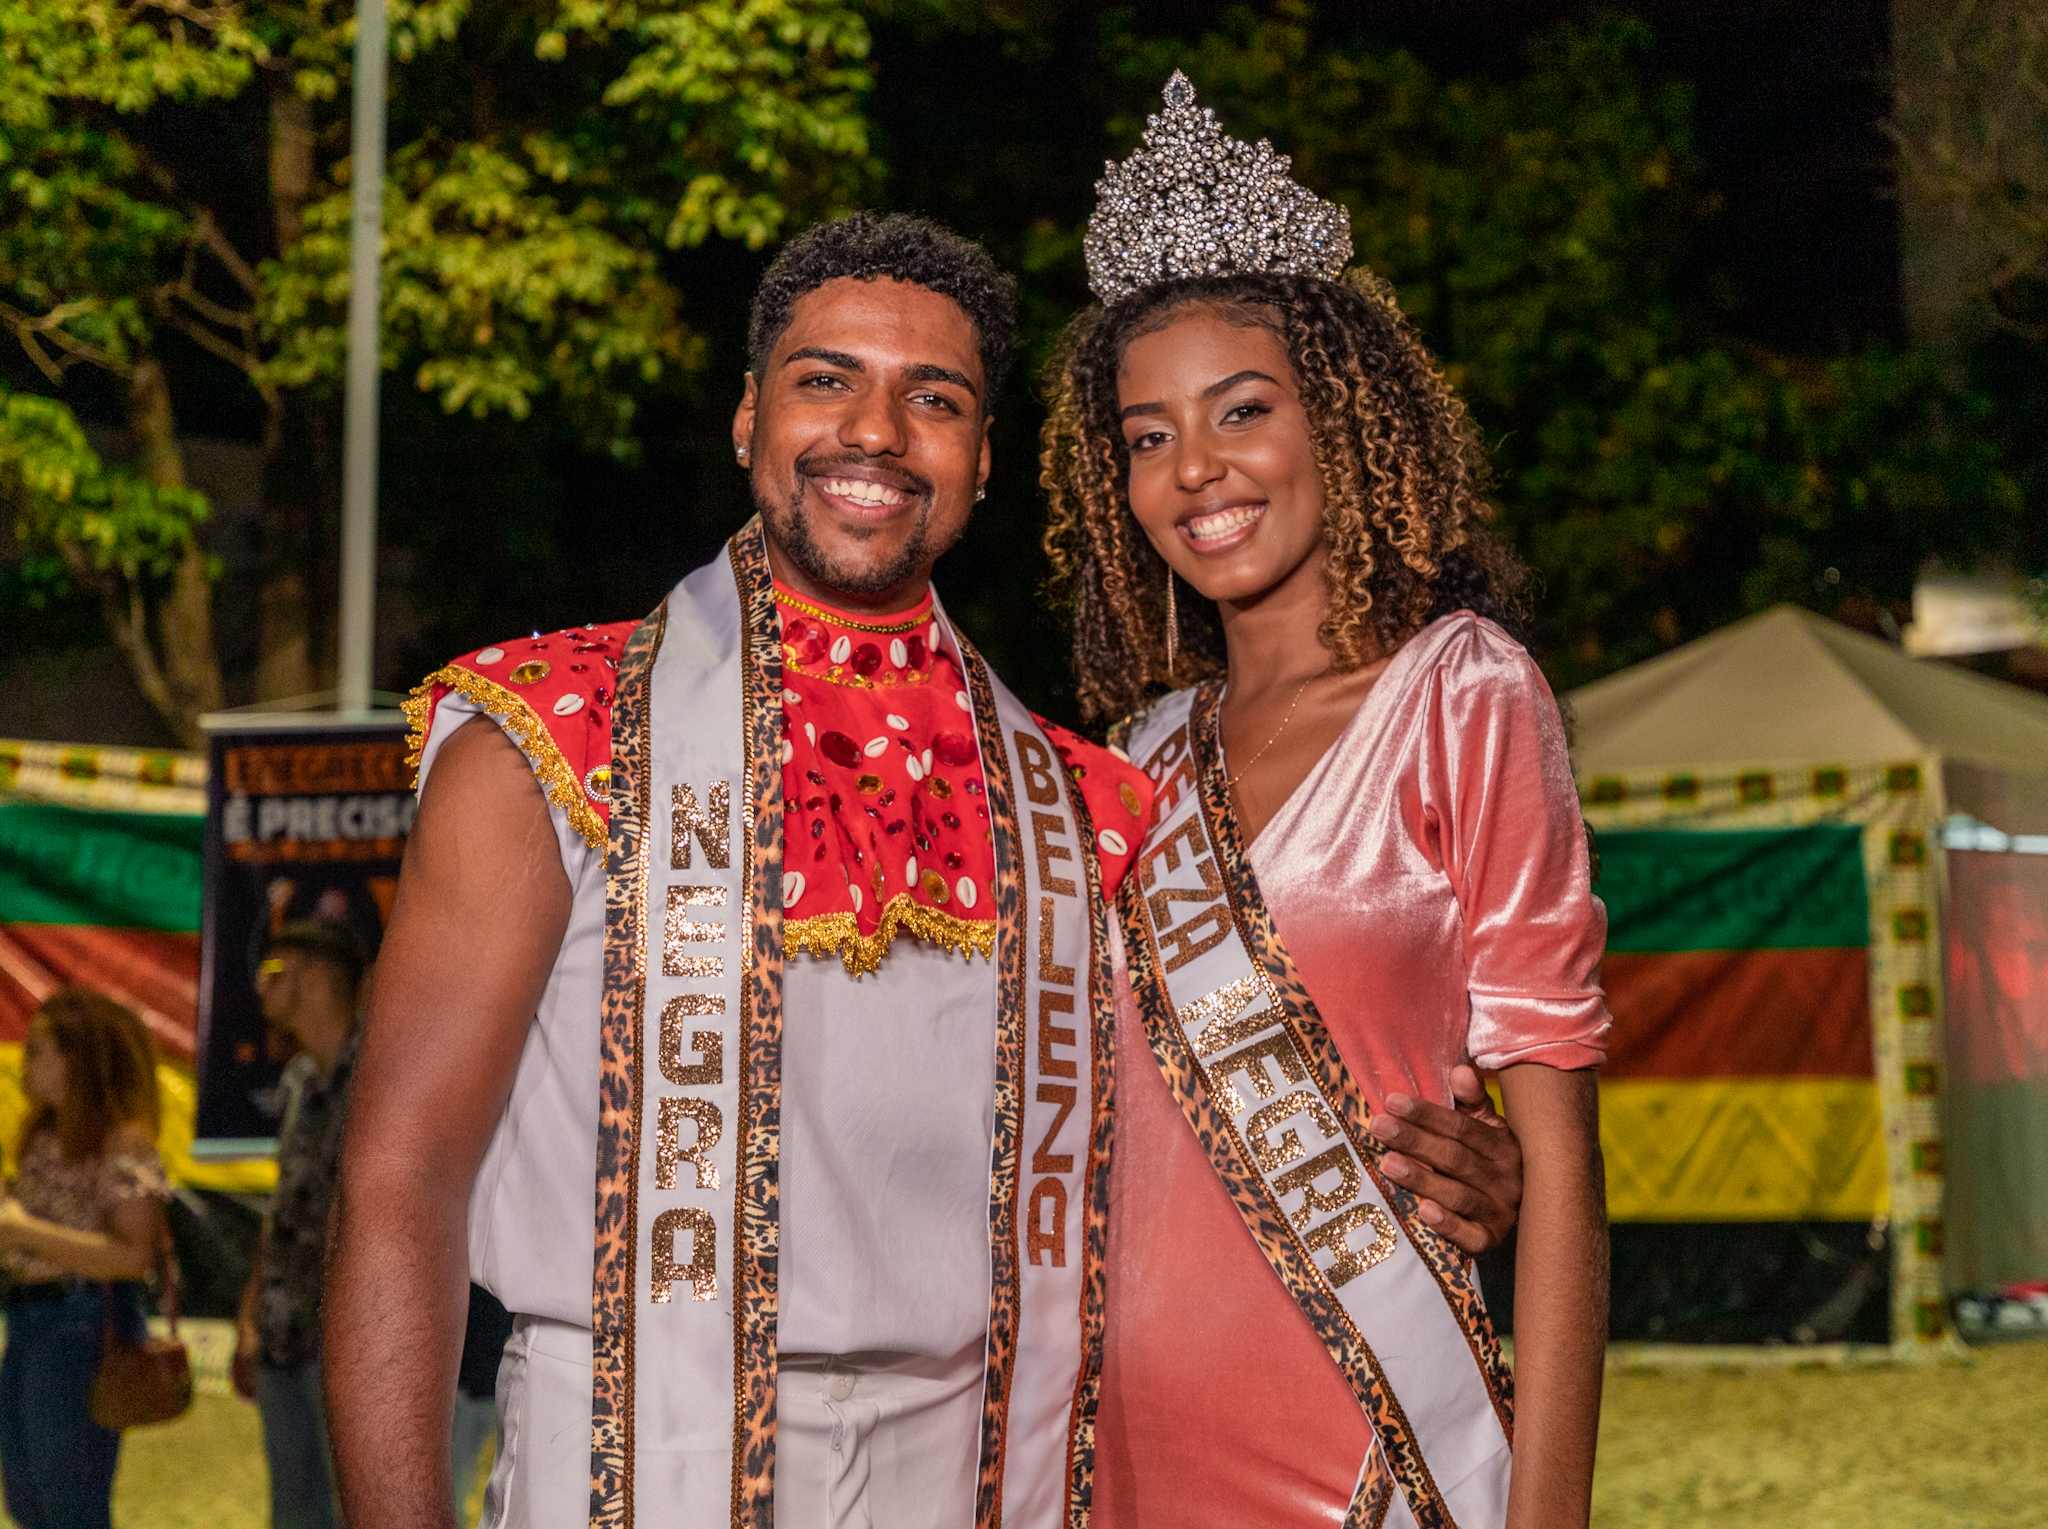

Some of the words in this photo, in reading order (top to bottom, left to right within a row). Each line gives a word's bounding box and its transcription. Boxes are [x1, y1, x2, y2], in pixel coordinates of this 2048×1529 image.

[650, 778, 731, 1304] NEGRA
[1012, 729, 1078, 1268] BELEZA
[1138, 723, 1234, 975] BEEZA
[1176, 973, 1398, 1289] NEGRA
